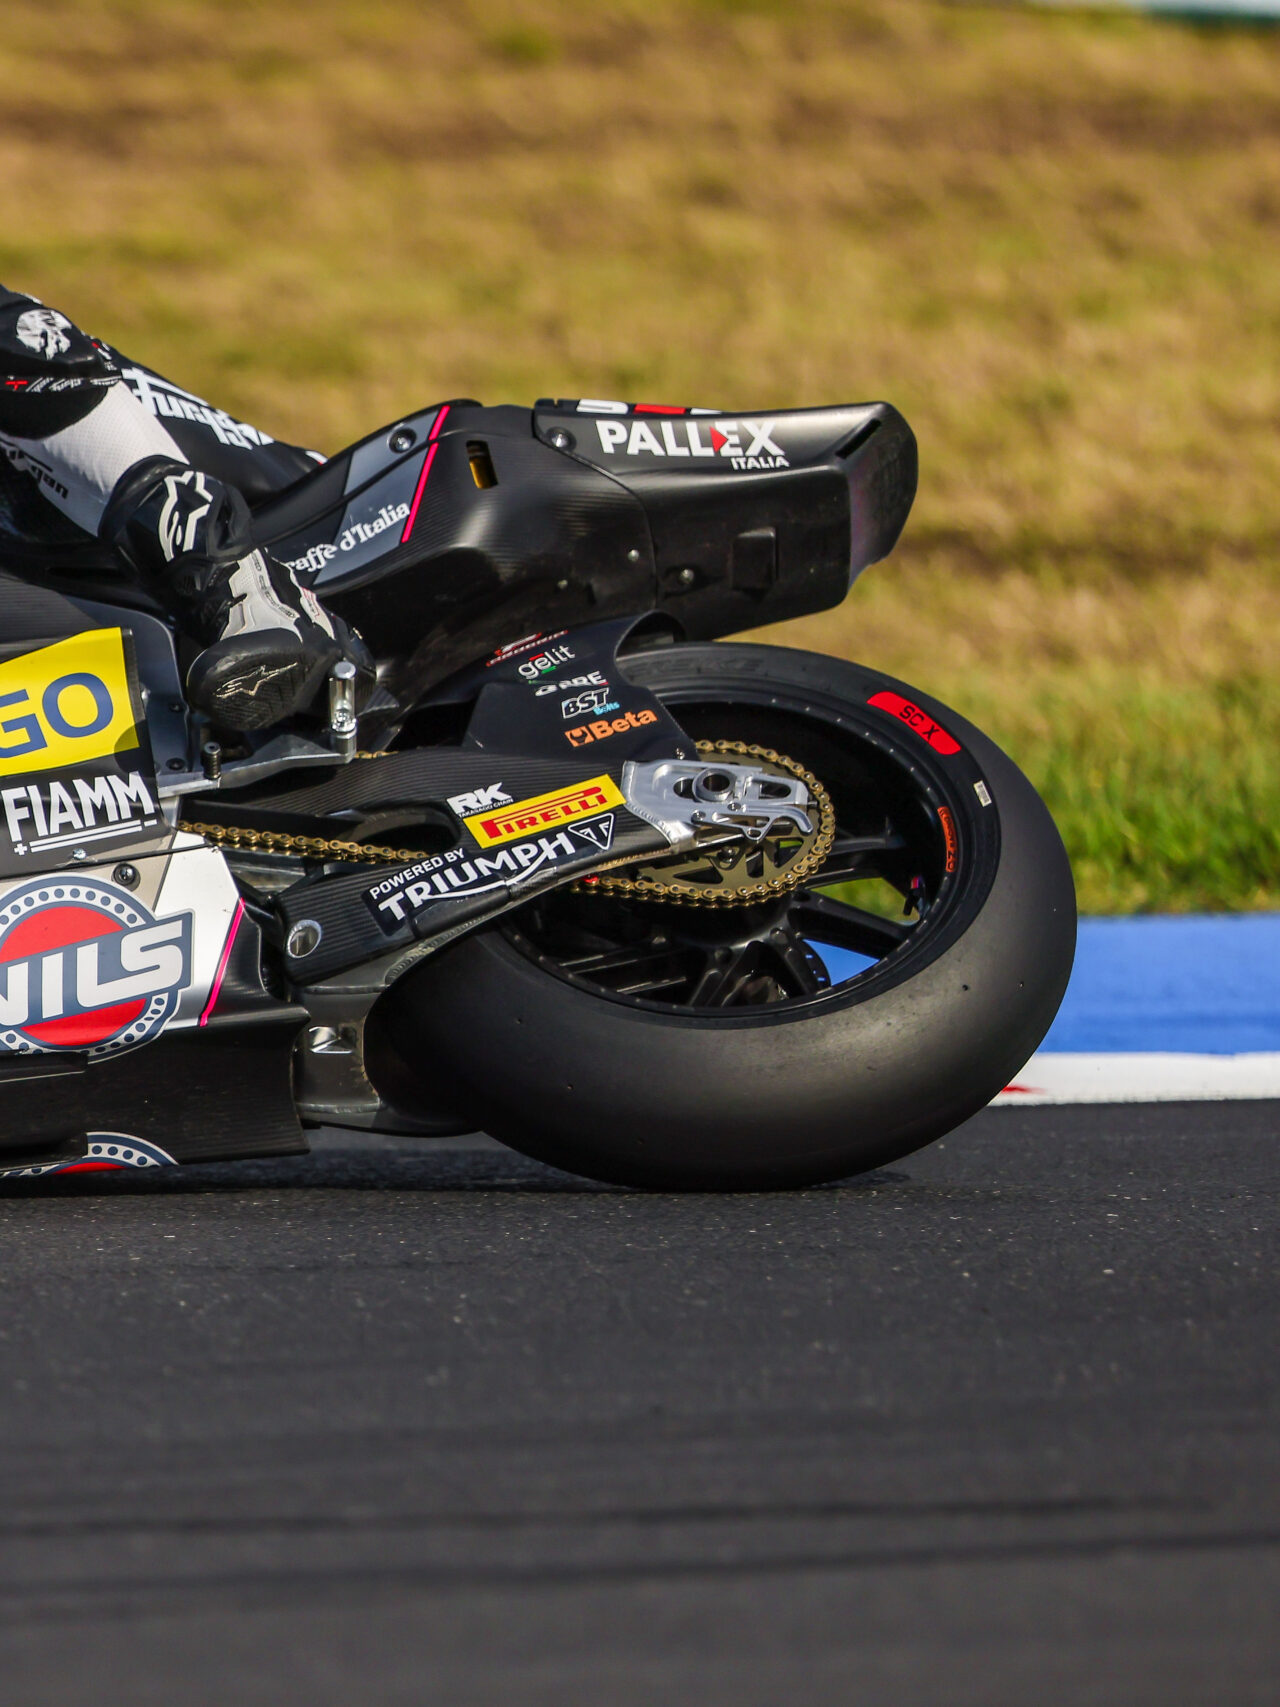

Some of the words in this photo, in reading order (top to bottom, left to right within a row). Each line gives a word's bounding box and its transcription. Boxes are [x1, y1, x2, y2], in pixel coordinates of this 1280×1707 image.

[595, 419, 786, 458] PALLEX
[730, 455, 790, 471] ITALIA
[340, 502, 411, 552] d'Italia
[518, 645, 576, 680] gelit
[561, 687, 610, 719] BST
[589, 708, 658, 740] Beta
[1, 772, 156, 842] FIAMM
[446, 781, 511, 814] RK
[479, 786, 608, 839] PIRELLI
[369, 855, 444, 899] POWERED
[446, 848, 464, 864] BY
[378, 831, 576, 921] TRIUMPH
